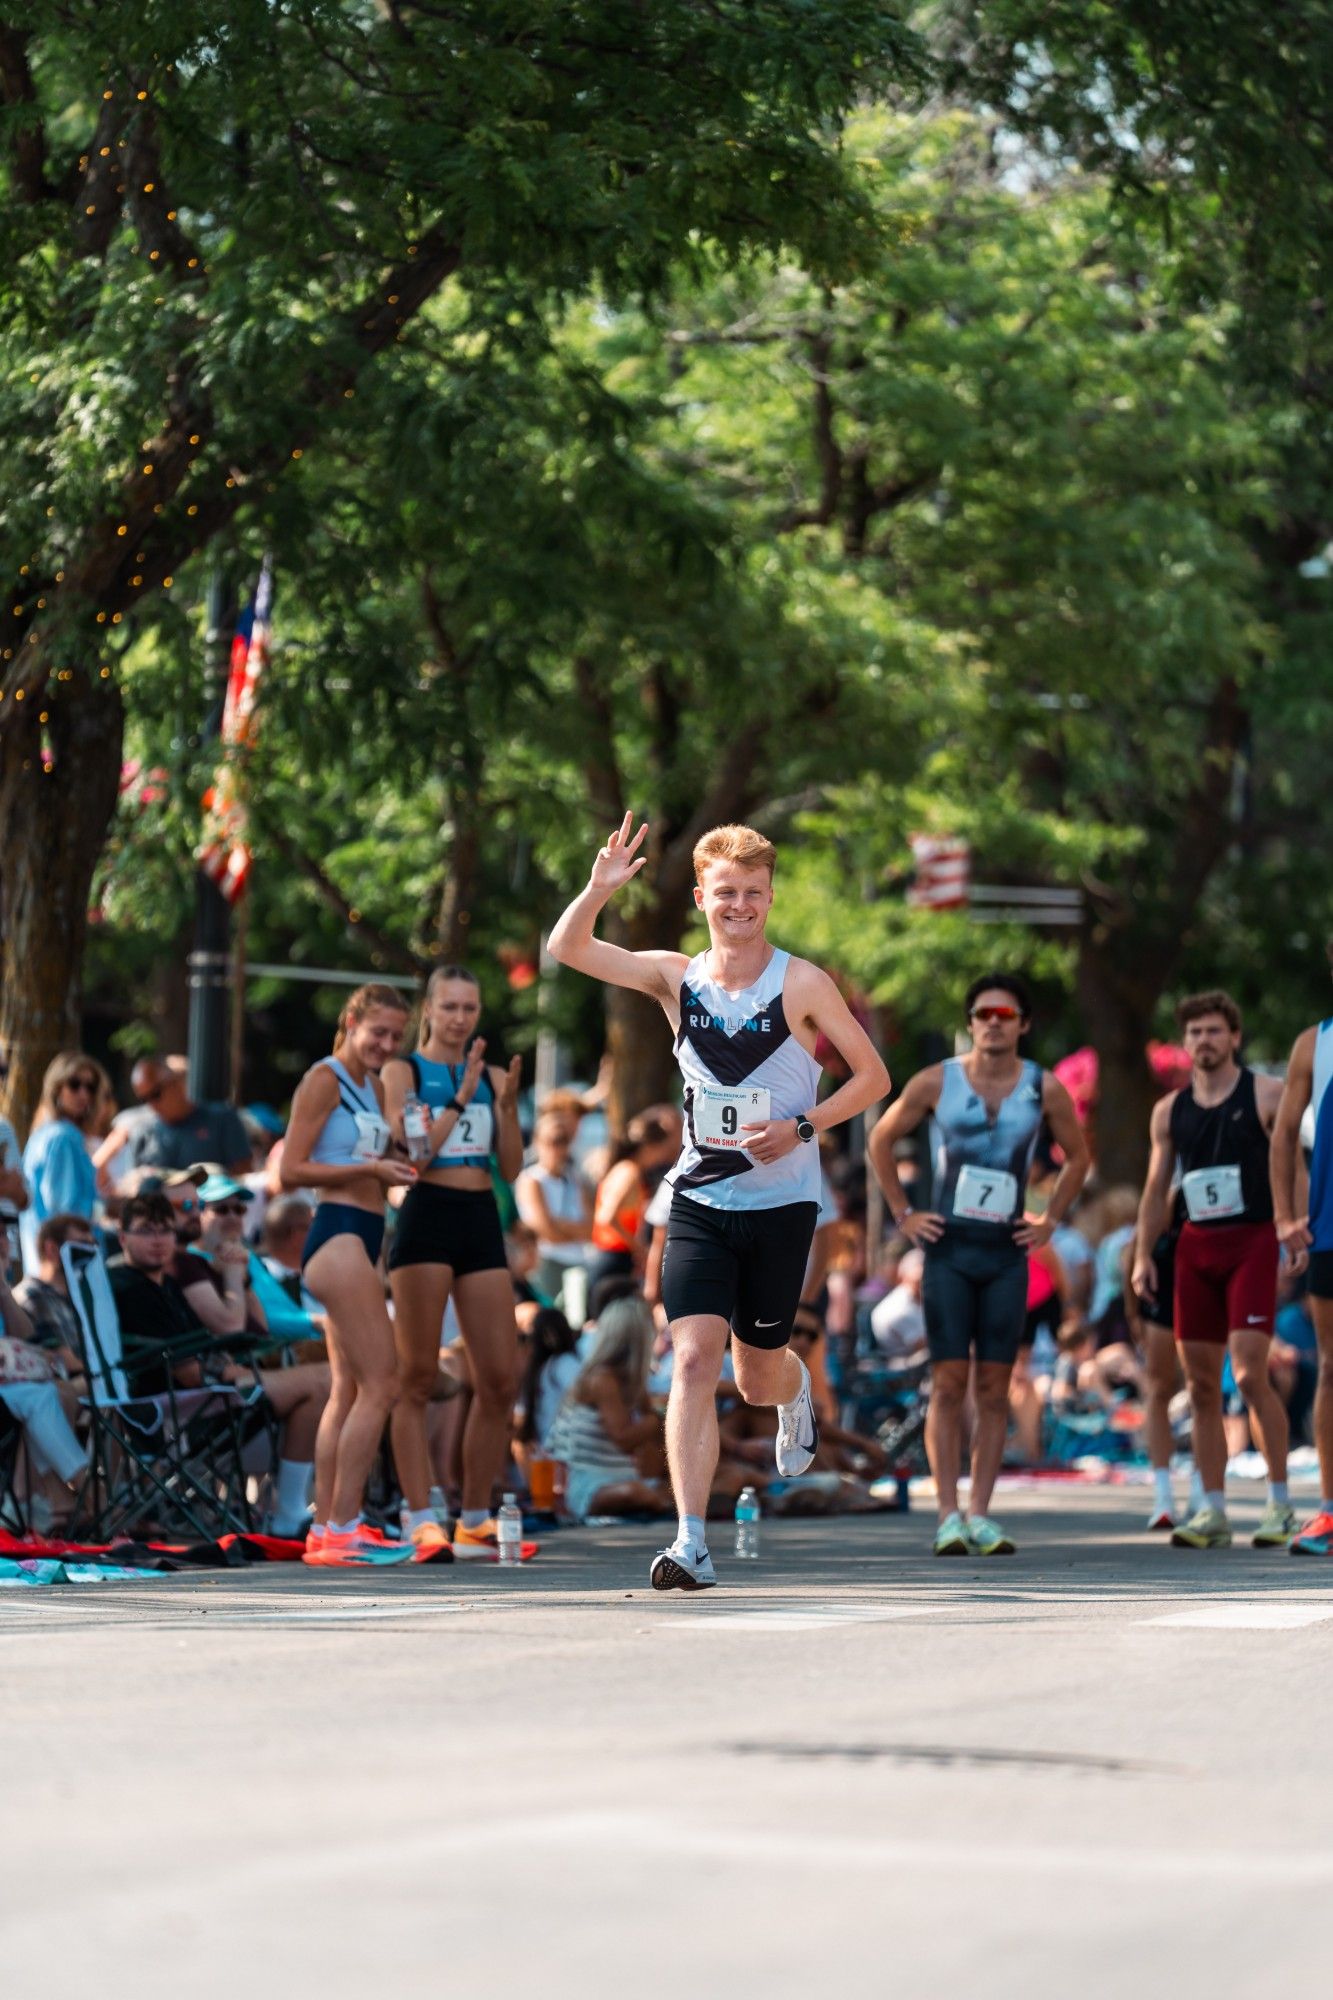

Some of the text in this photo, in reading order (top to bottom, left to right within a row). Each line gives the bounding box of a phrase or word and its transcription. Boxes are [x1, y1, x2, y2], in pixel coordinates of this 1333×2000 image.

[689, 1014, 771, 1032] RUNLINE
[459, 1119, 473, 1143] 2
[721, 1105, 737, 1135] 9
[705, 1136, 721, 1146] RYAN
[722, 1138, 738, 1147] SHAY
[979, 1184, 993, 1207] 7
[1206, 1183, 1218, 1205] 5
